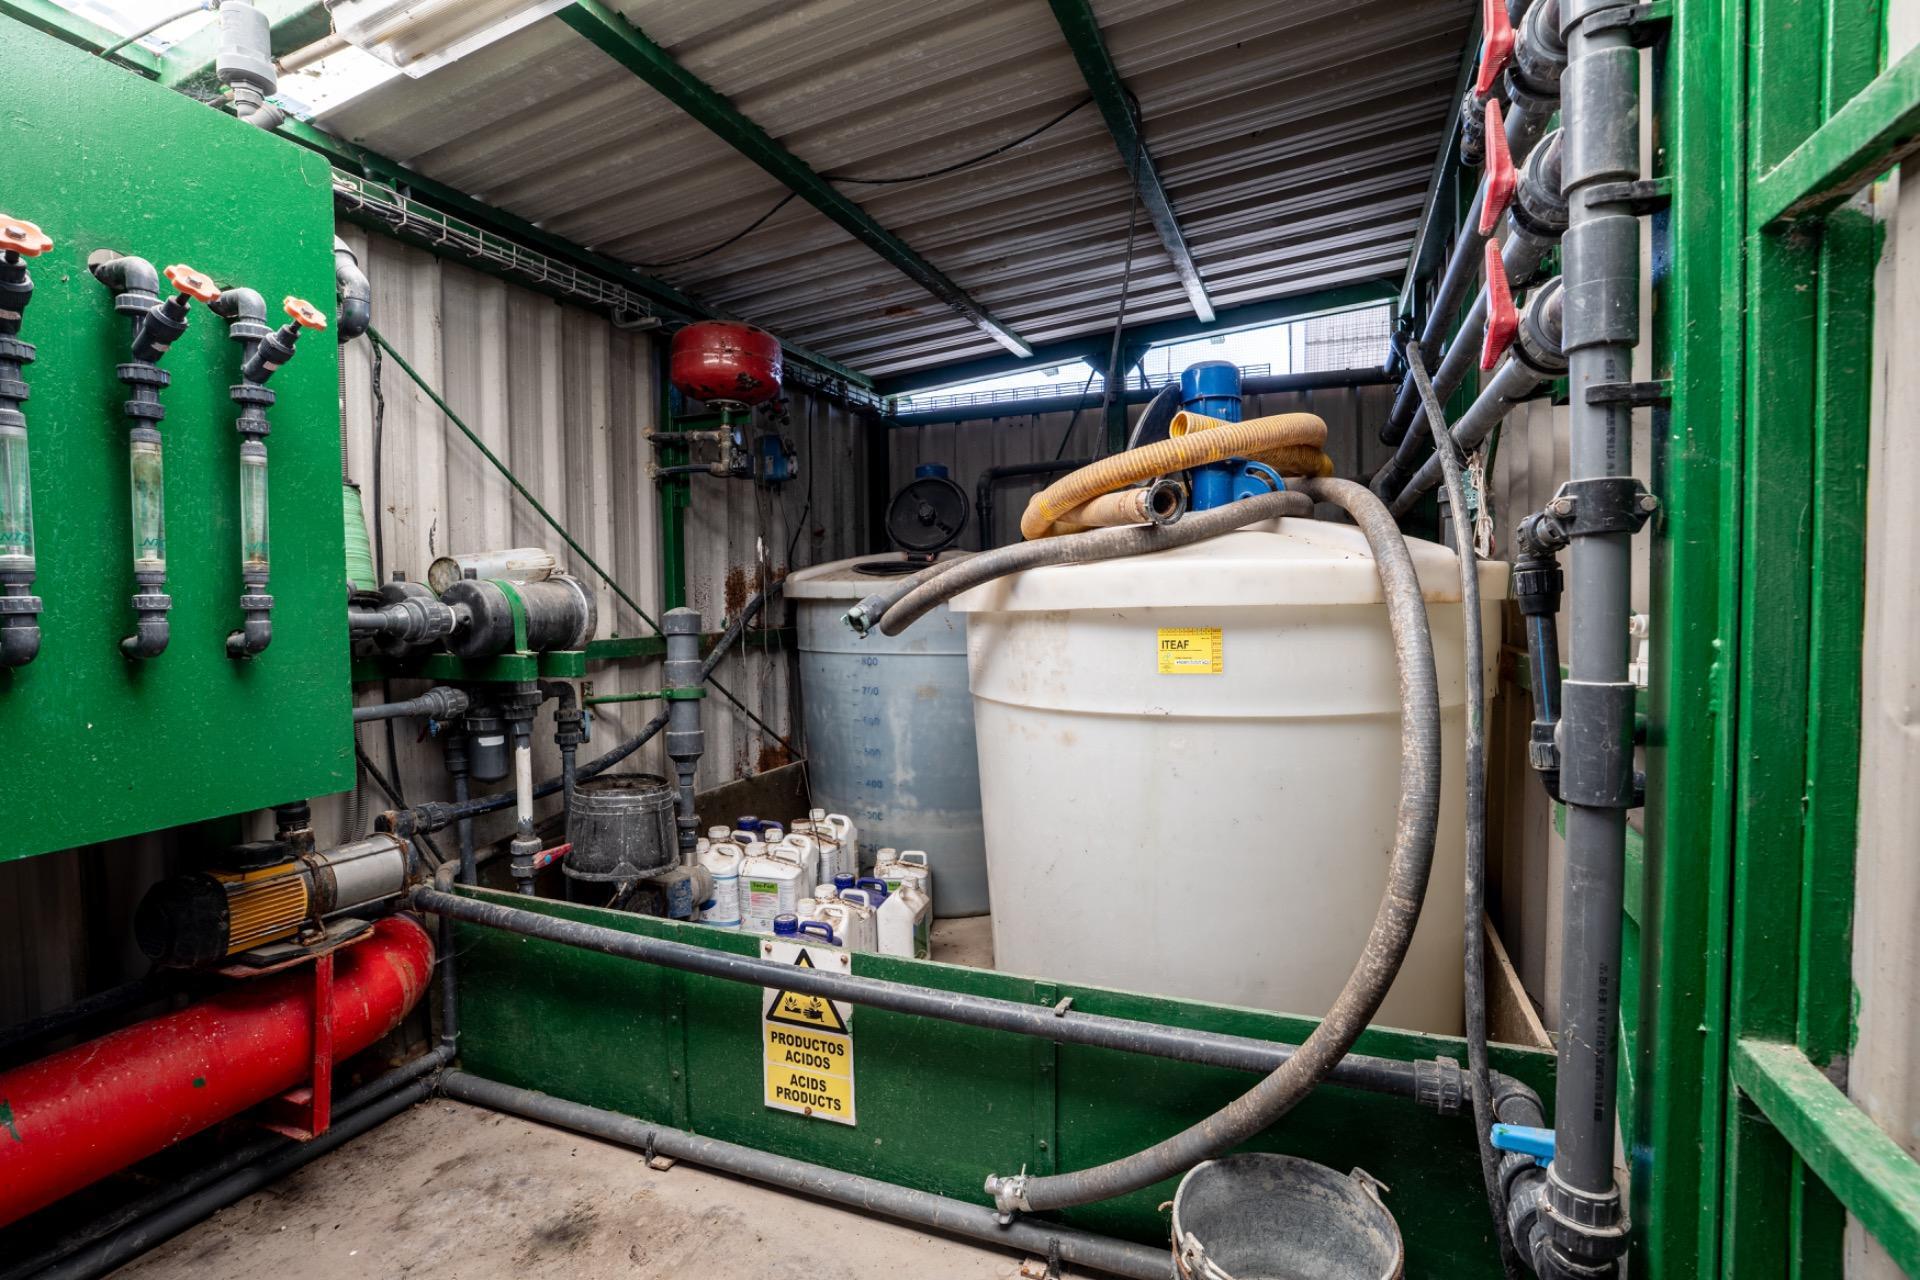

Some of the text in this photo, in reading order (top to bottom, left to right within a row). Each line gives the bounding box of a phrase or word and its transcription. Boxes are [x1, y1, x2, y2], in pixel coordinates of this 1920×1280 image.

[1162, 640, 1189, 649] ITEAF
[771, 1031, 844, 1056] PRODUCTOS
[785, 1050, 831, 1069] ACIDOS
[790, 1074, 827, 1092] ACIDS
[776, 1086, 841, 1111] PRODUCTS
